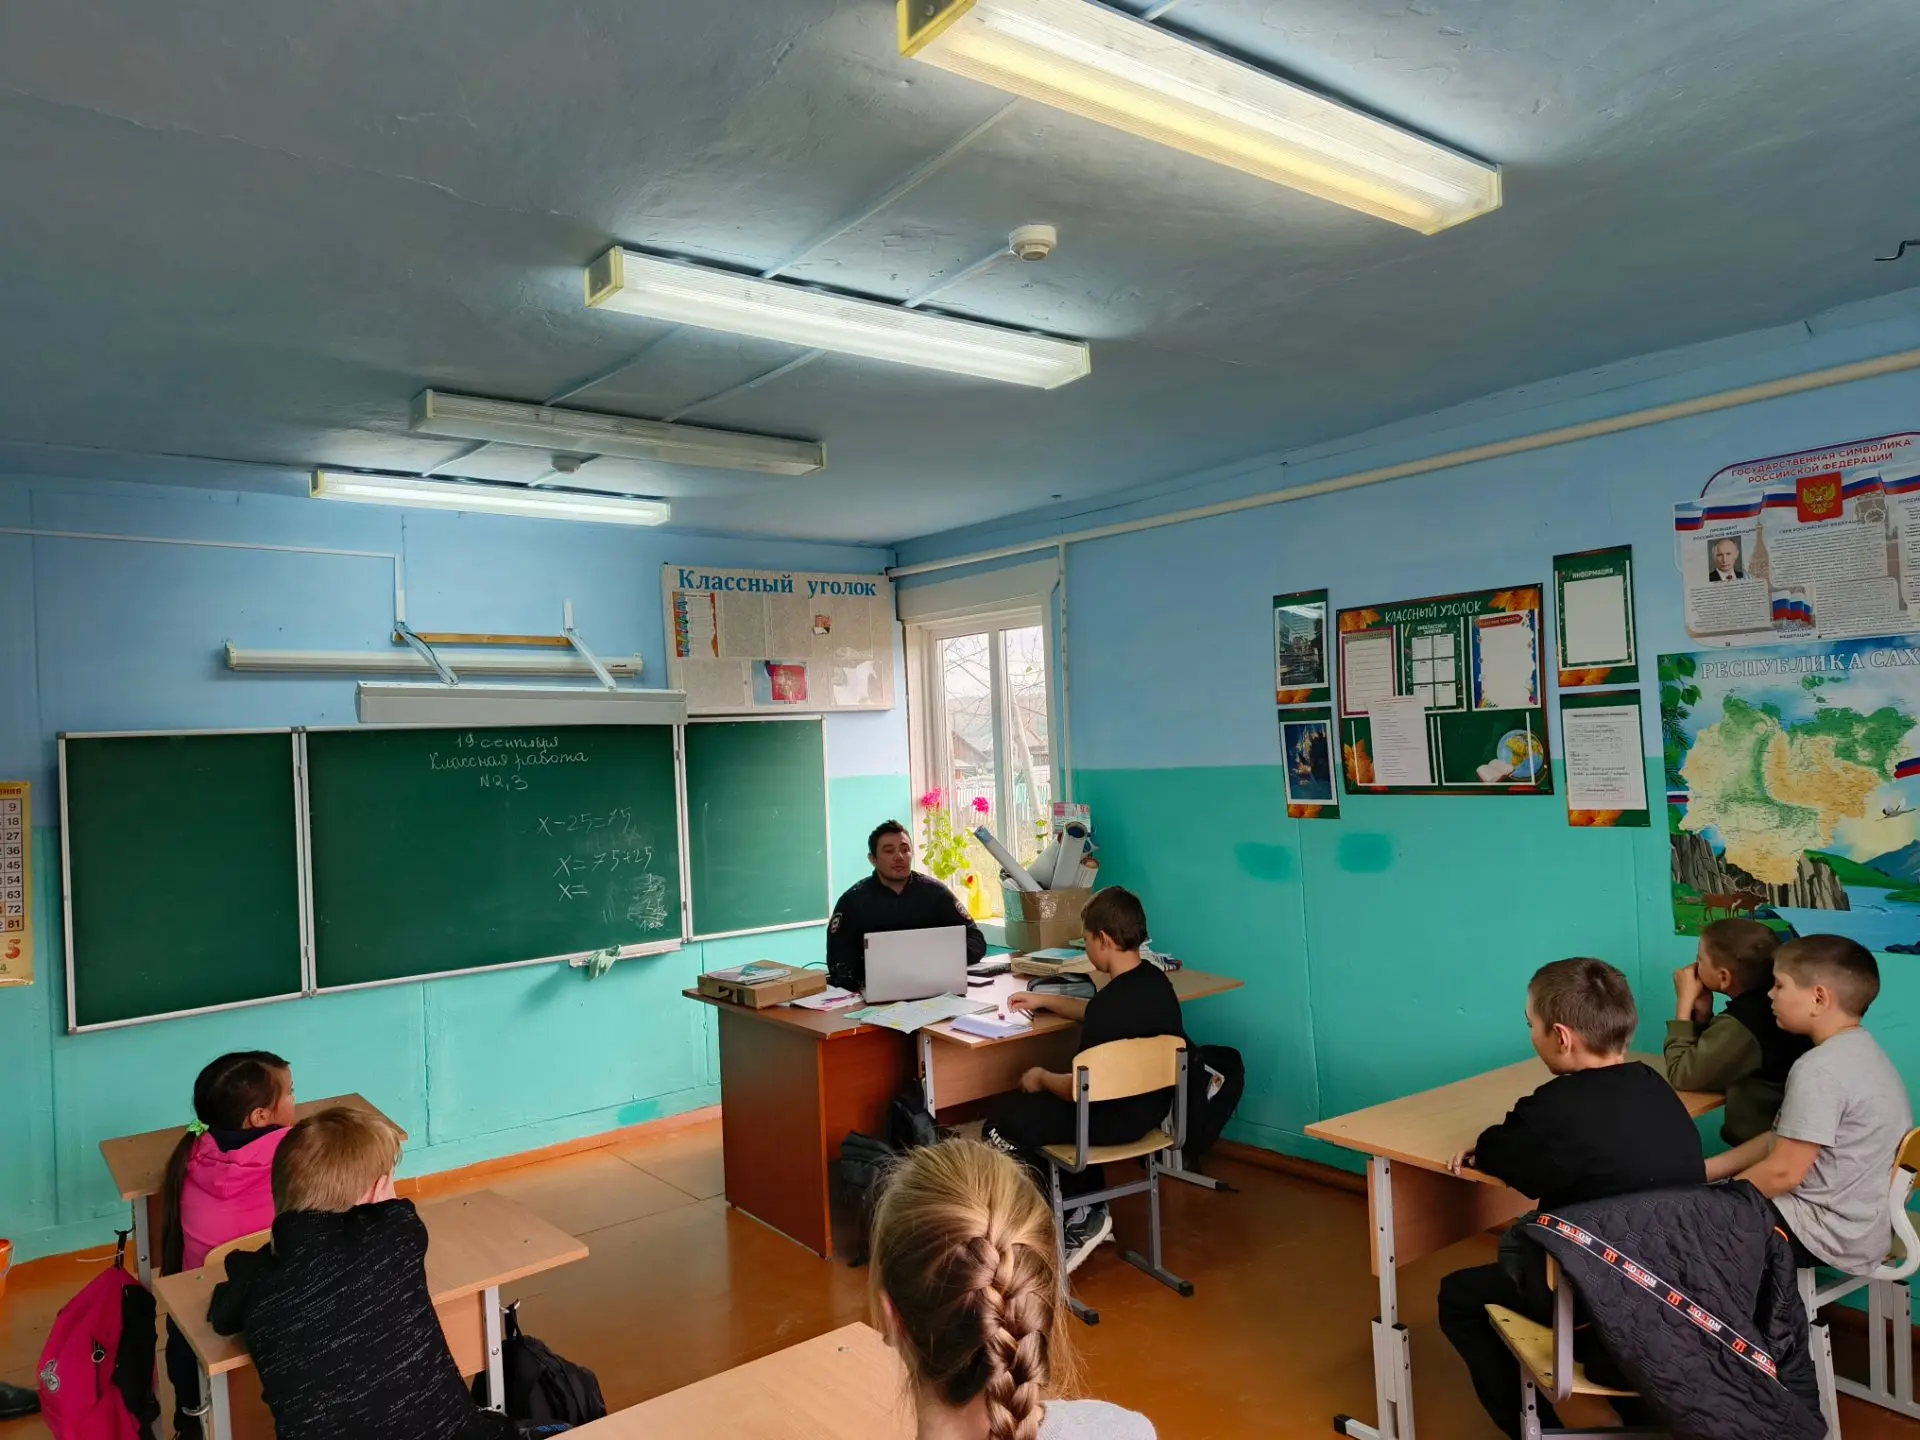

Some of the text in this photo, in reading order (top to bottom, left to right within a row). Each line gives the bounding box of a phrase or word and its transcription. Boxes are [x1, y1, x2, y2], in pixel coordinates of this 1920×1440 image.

[1731, 438, 1912, 477] ГОСУДАРСТВЕННАЯ СИМВОЛИКА
[1748, 452, 1893, 484] РОССИЙСКОЙ ФЕДЕРАЦИИ
[678, 568, 877, 599] Классный уголок
[1385, 600, 1482, 624] КЛАССНЫЙ УГОЛОК
[1701, 652, 1866, 680] РЕСПУБЛИКА
[455, 733, 475, 748] 19
[429, 750, 589, 772] Классная работа
[8, 802, 17, 812] 9
[7, 817, 19, 826] 18
[6, 832, 20, 841] 27
[6, 846, 20, 855] 36
[7, 861, 20, 870] 45
[7, 875, 20, 884] 54
[7, 890, 21, 899] 63
[8, 904, 21, 914] 72
[8, 919, 20, 929] 81
